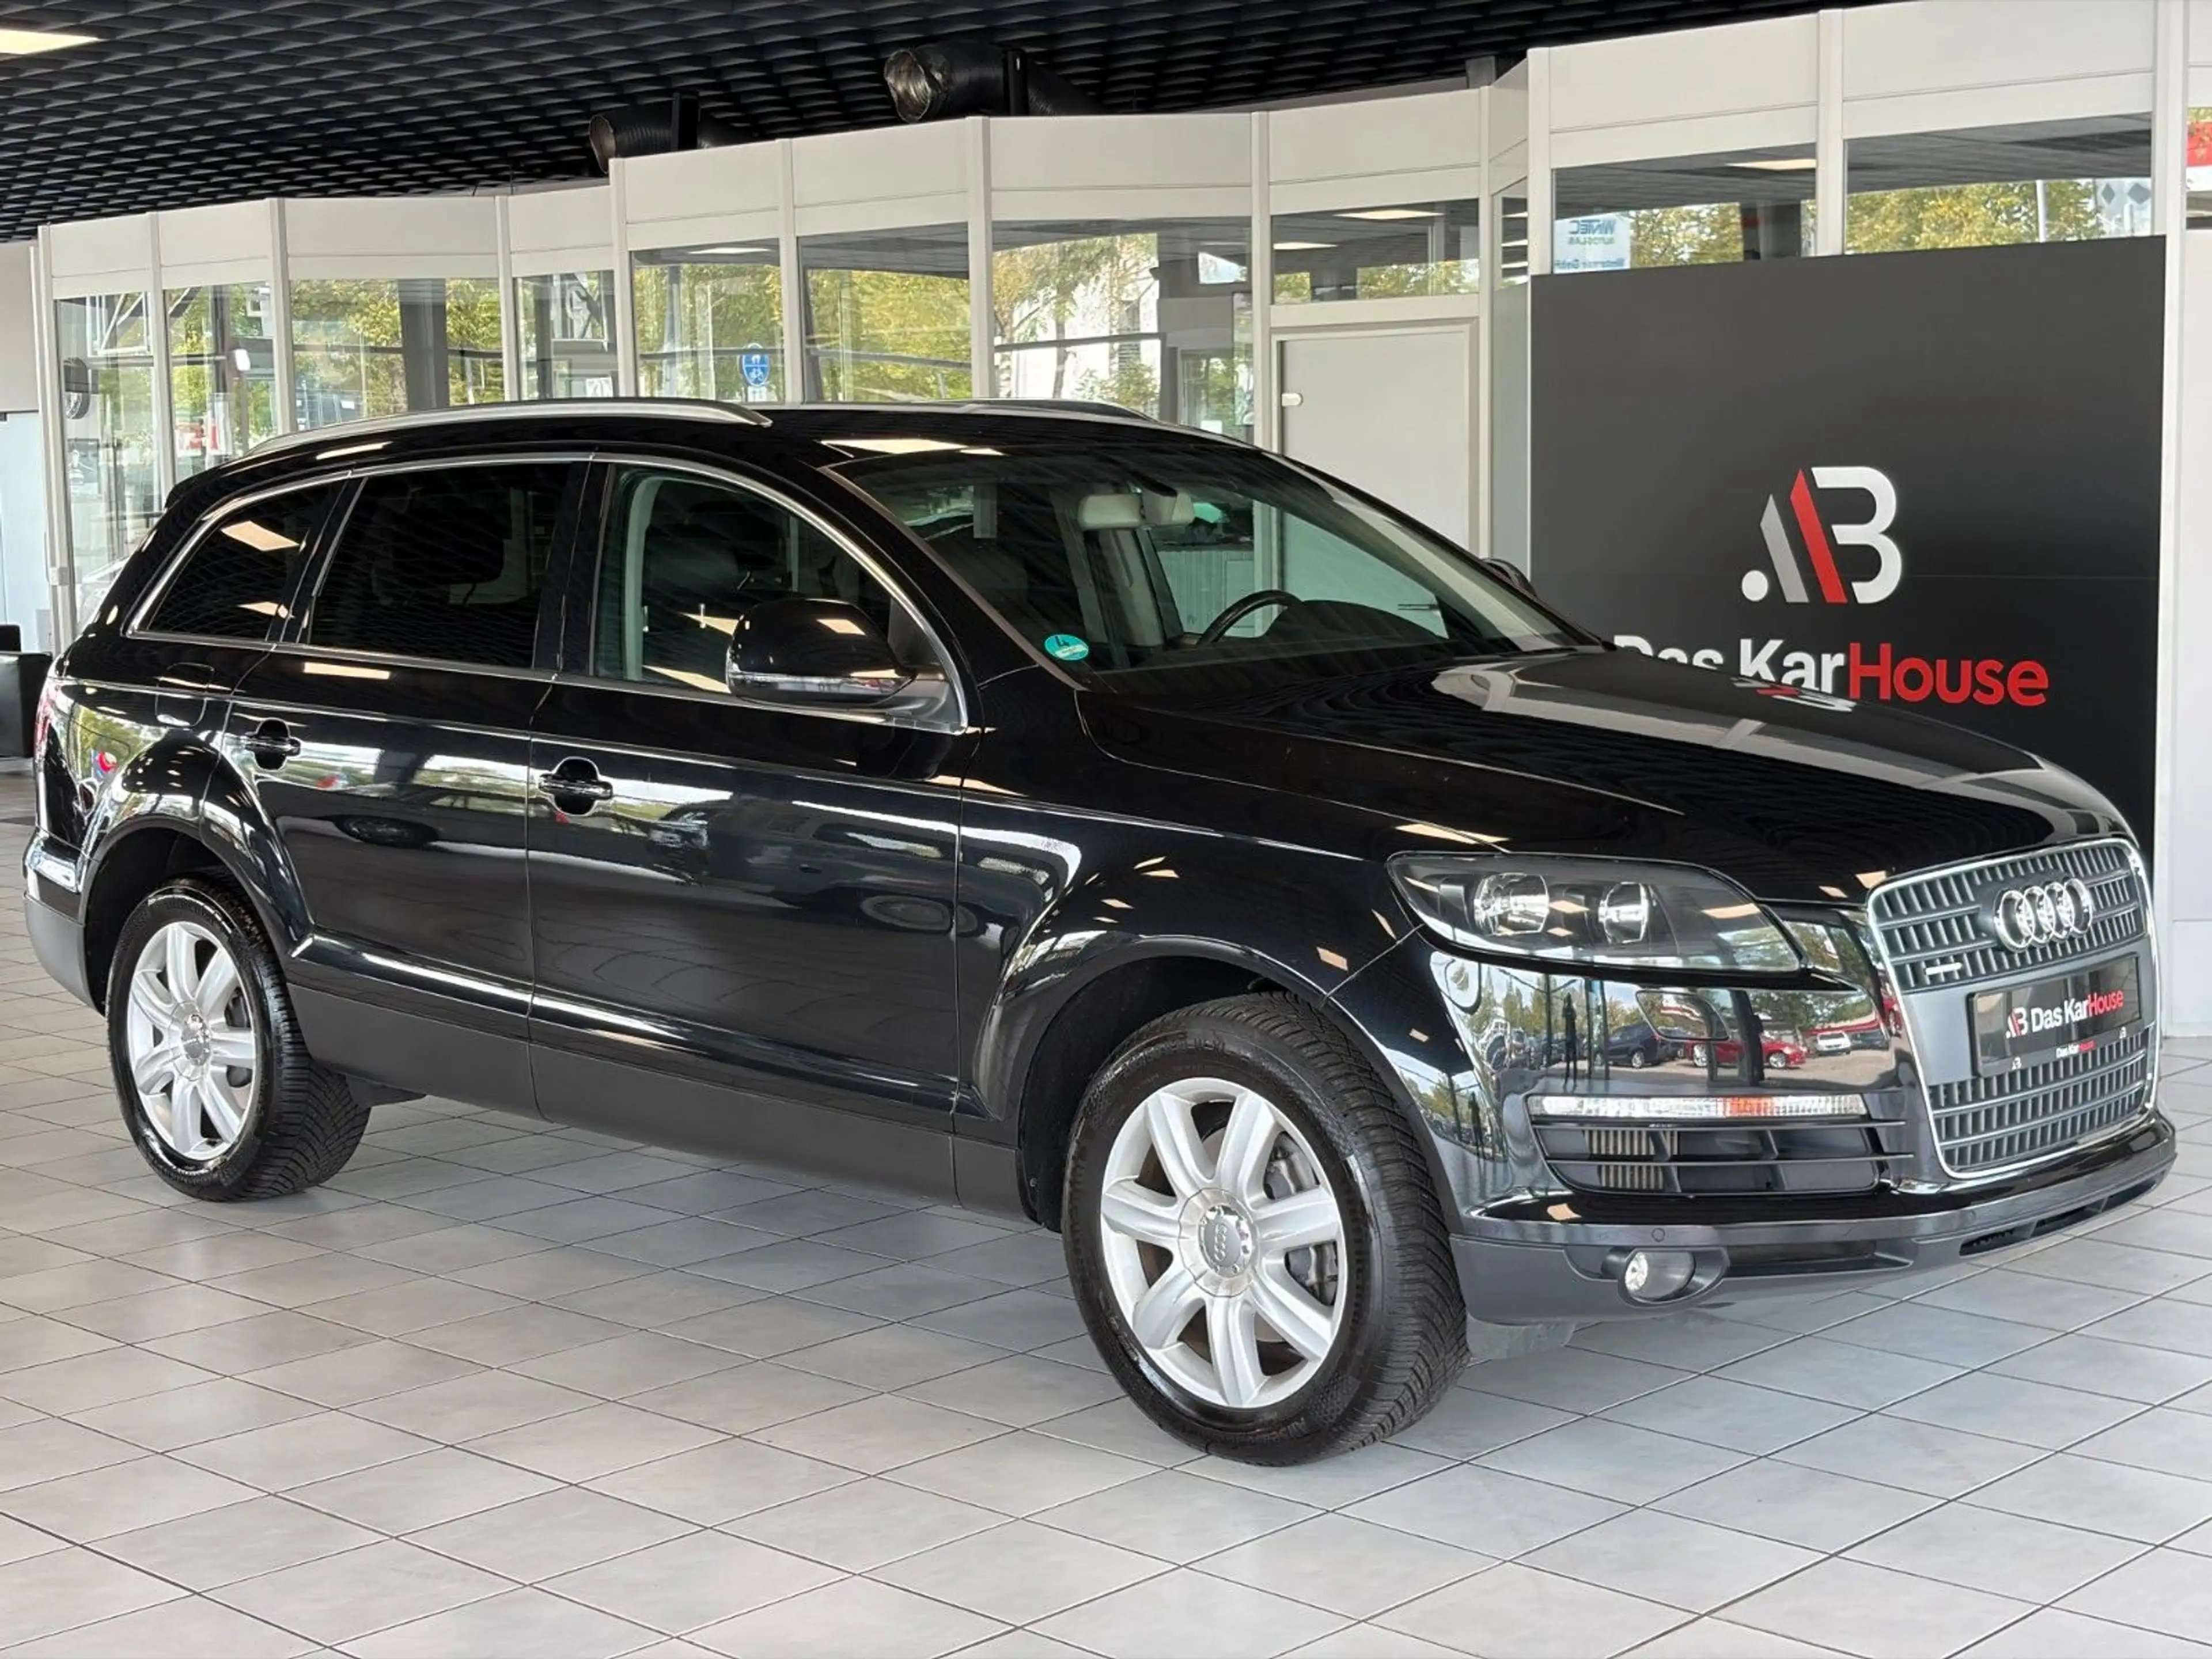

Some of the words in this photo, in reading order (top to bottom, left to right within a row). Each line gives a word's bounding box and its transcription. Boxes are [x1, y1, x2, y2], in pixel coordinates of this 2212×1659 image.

[1739, 638, 2048, 706] KarHouse
[2031, 1007, 2063, 1033] Das
[2064, 988, 2124, 1024] KarHouse
